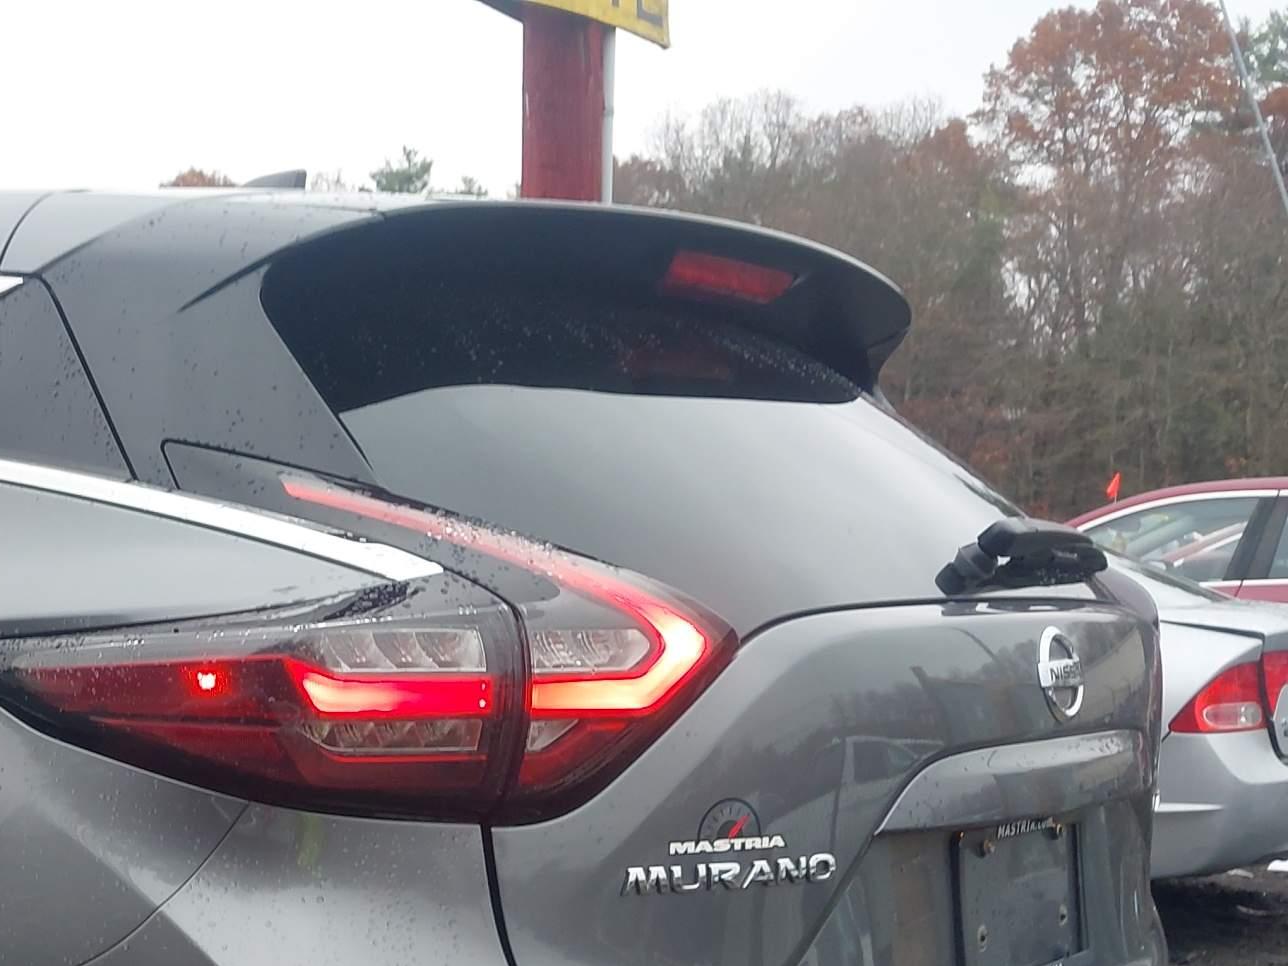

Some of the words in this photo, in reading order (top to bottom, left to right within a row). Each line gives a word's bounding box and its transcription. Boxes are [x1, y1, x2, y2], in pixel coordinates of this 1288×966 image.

[1049, 661, 1080, 681] NISS
[669, 834, 786, 856] MASTRIA
[621, 852, 837, 896] MURANO
